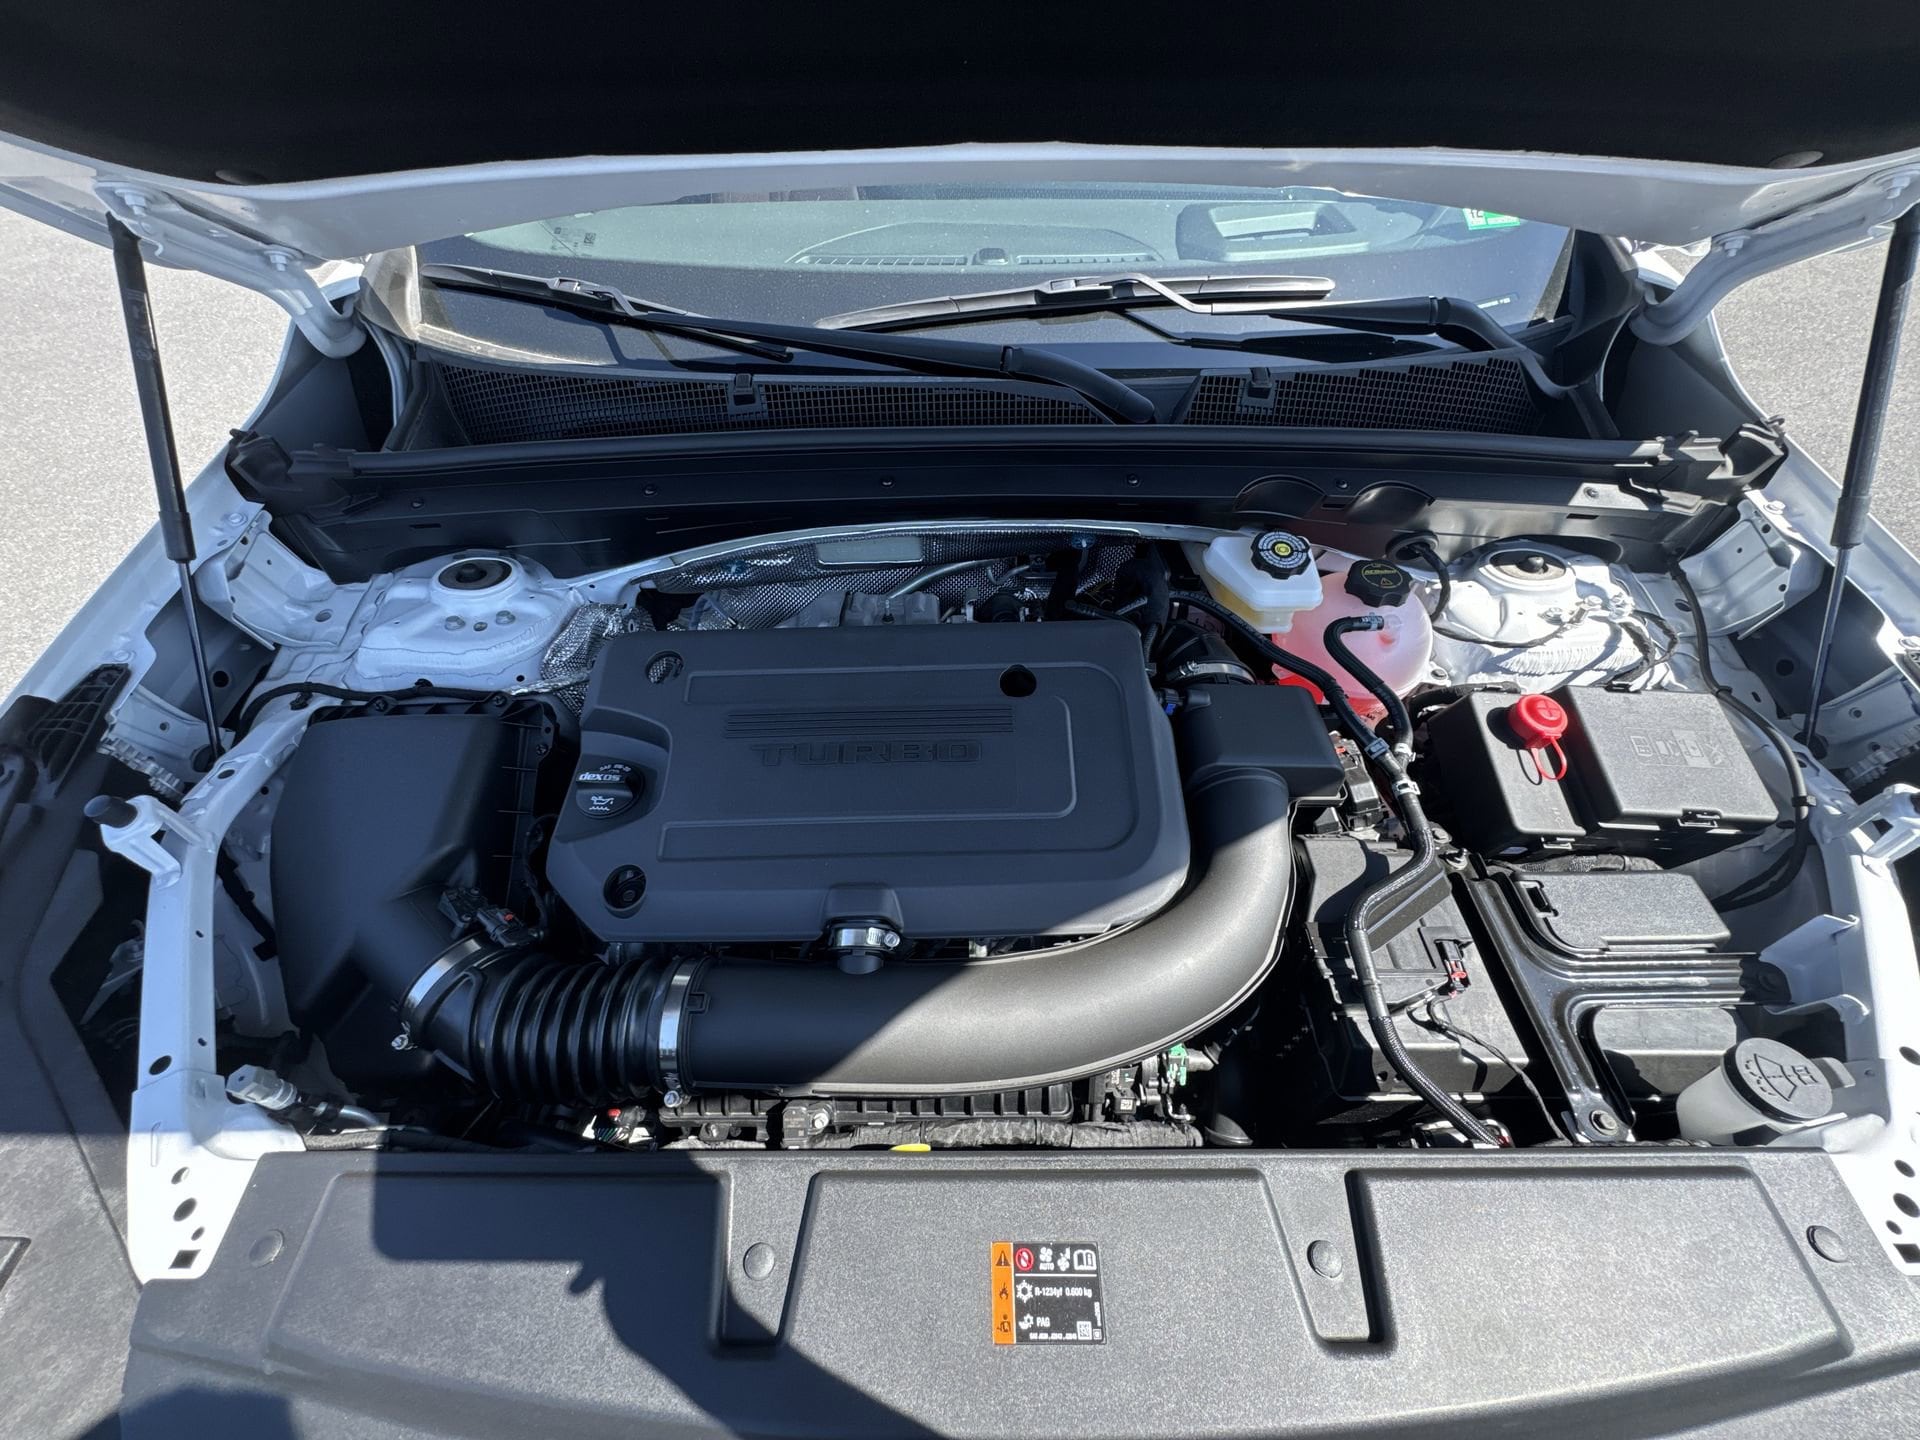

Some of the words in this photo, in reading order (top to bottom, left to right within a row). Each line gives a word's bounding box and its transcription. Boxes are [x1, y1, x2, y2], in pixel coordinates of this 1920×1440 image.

[751, 740, 982, 766] TURBO
[579, 772, 621, 781] dexos
[1039, 1262, 1054, 1270] AUTO
[1035, 1287, 1063, 1298] R-1234yf
[1084, 1287, 1092, 1298] kg
[1036, 1317, 1050, 1327] PAG
